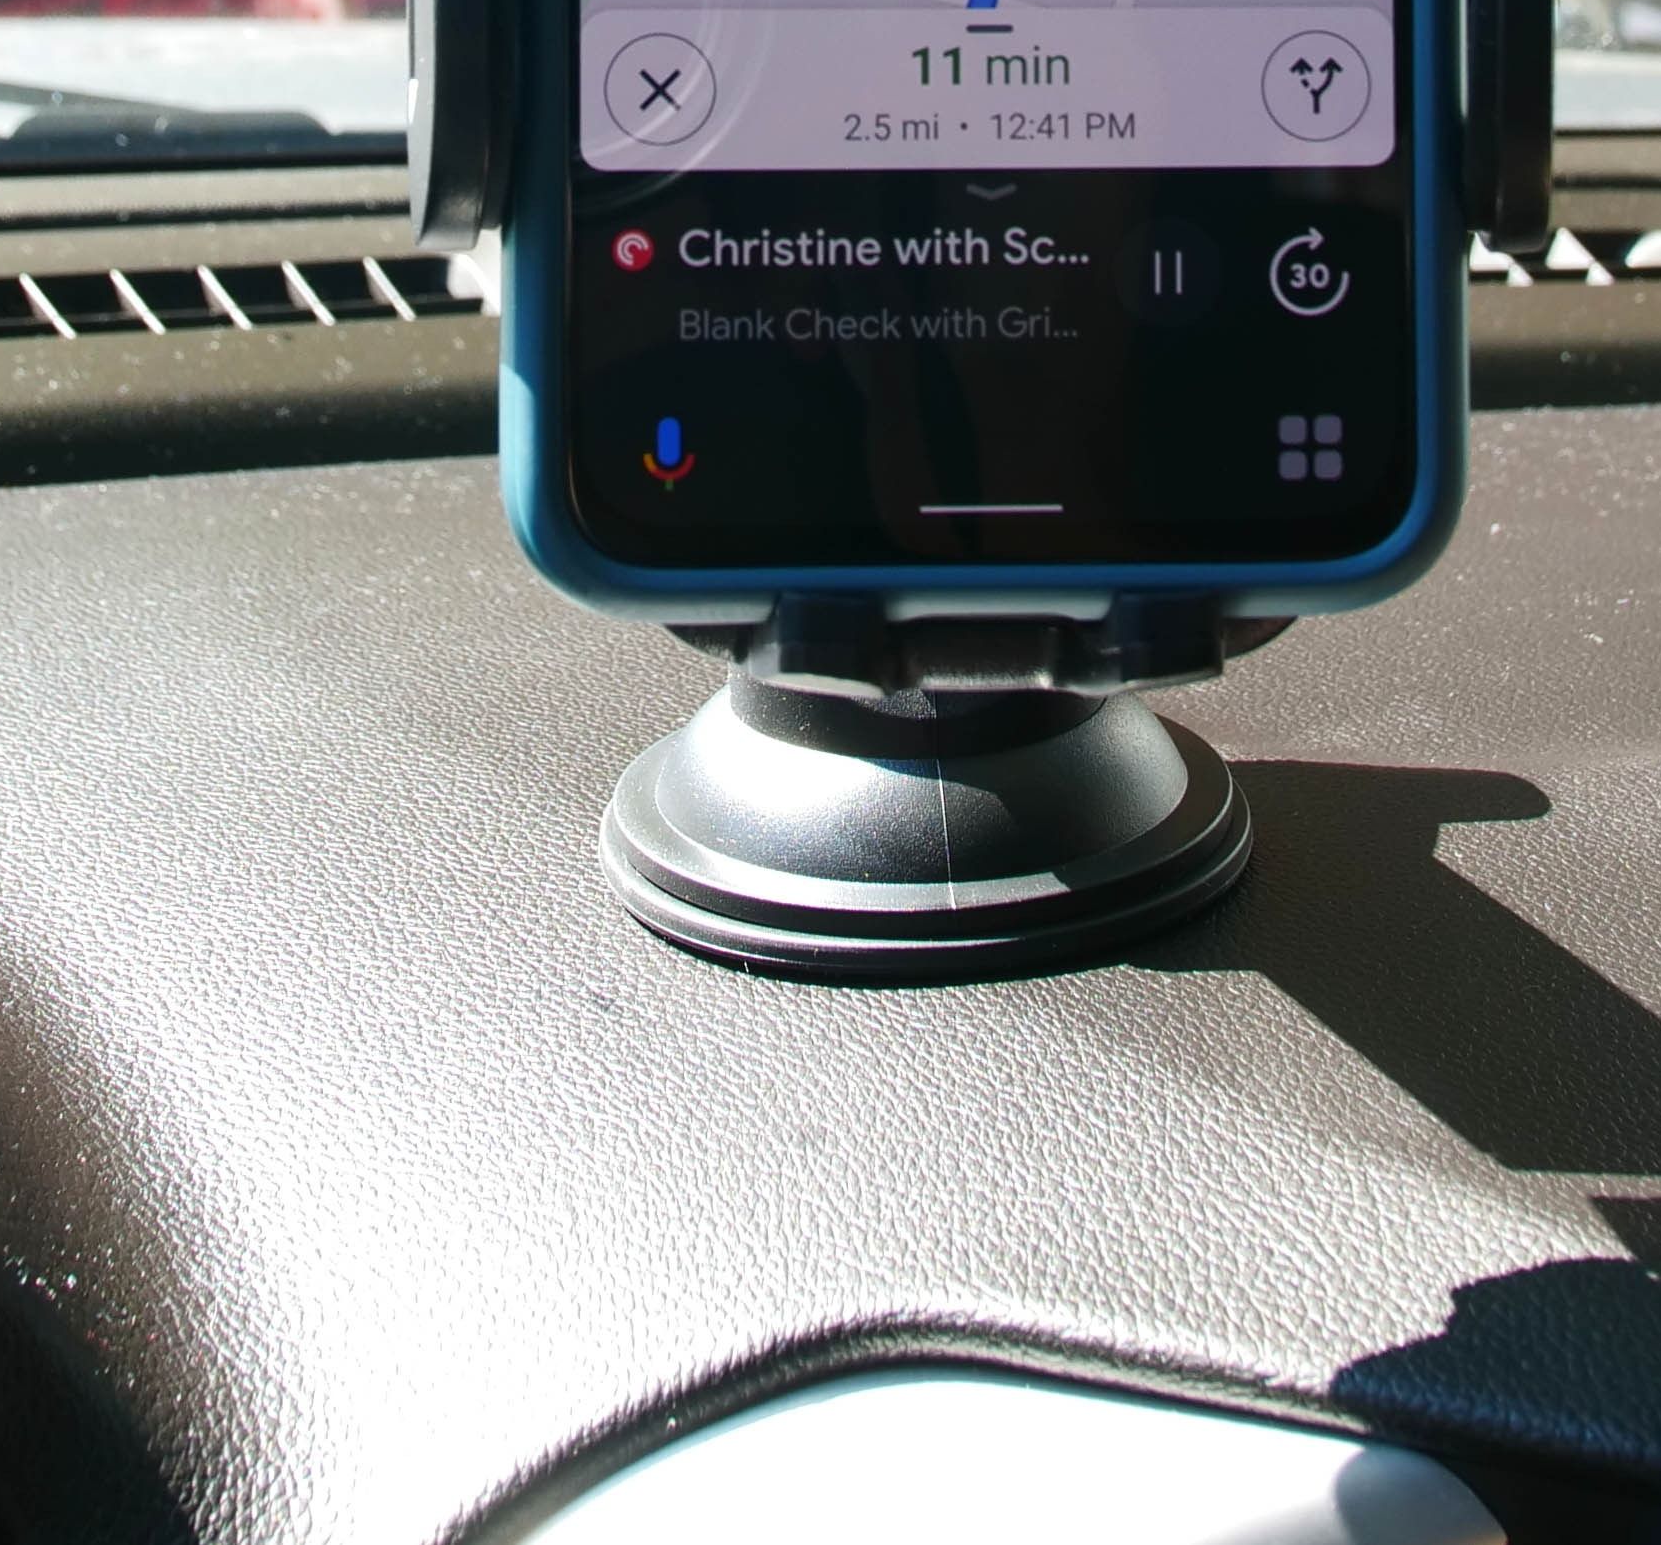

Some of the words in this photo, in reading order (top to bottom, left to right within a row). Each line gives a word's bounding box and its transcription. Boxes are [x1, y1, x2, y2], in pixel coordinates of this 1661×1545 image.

[911, 46, 962, 86] 11
[986, 44, 1071, 86] min
[842, 113, 892, 142] 2.5
[901, 113, 940, 141] mi
[990, 112, 1071, 140] 12:41
[1085, 111, 1137, 140] PM
[678, 227, 883, 268] Christine
[892, 227, 990, 266] with
[1289, 262, 1331, 290] 30
[678, 308, 776, 342] Blank
[785, 308, 901, 341] Check
[909, 308, 987, 339] with
